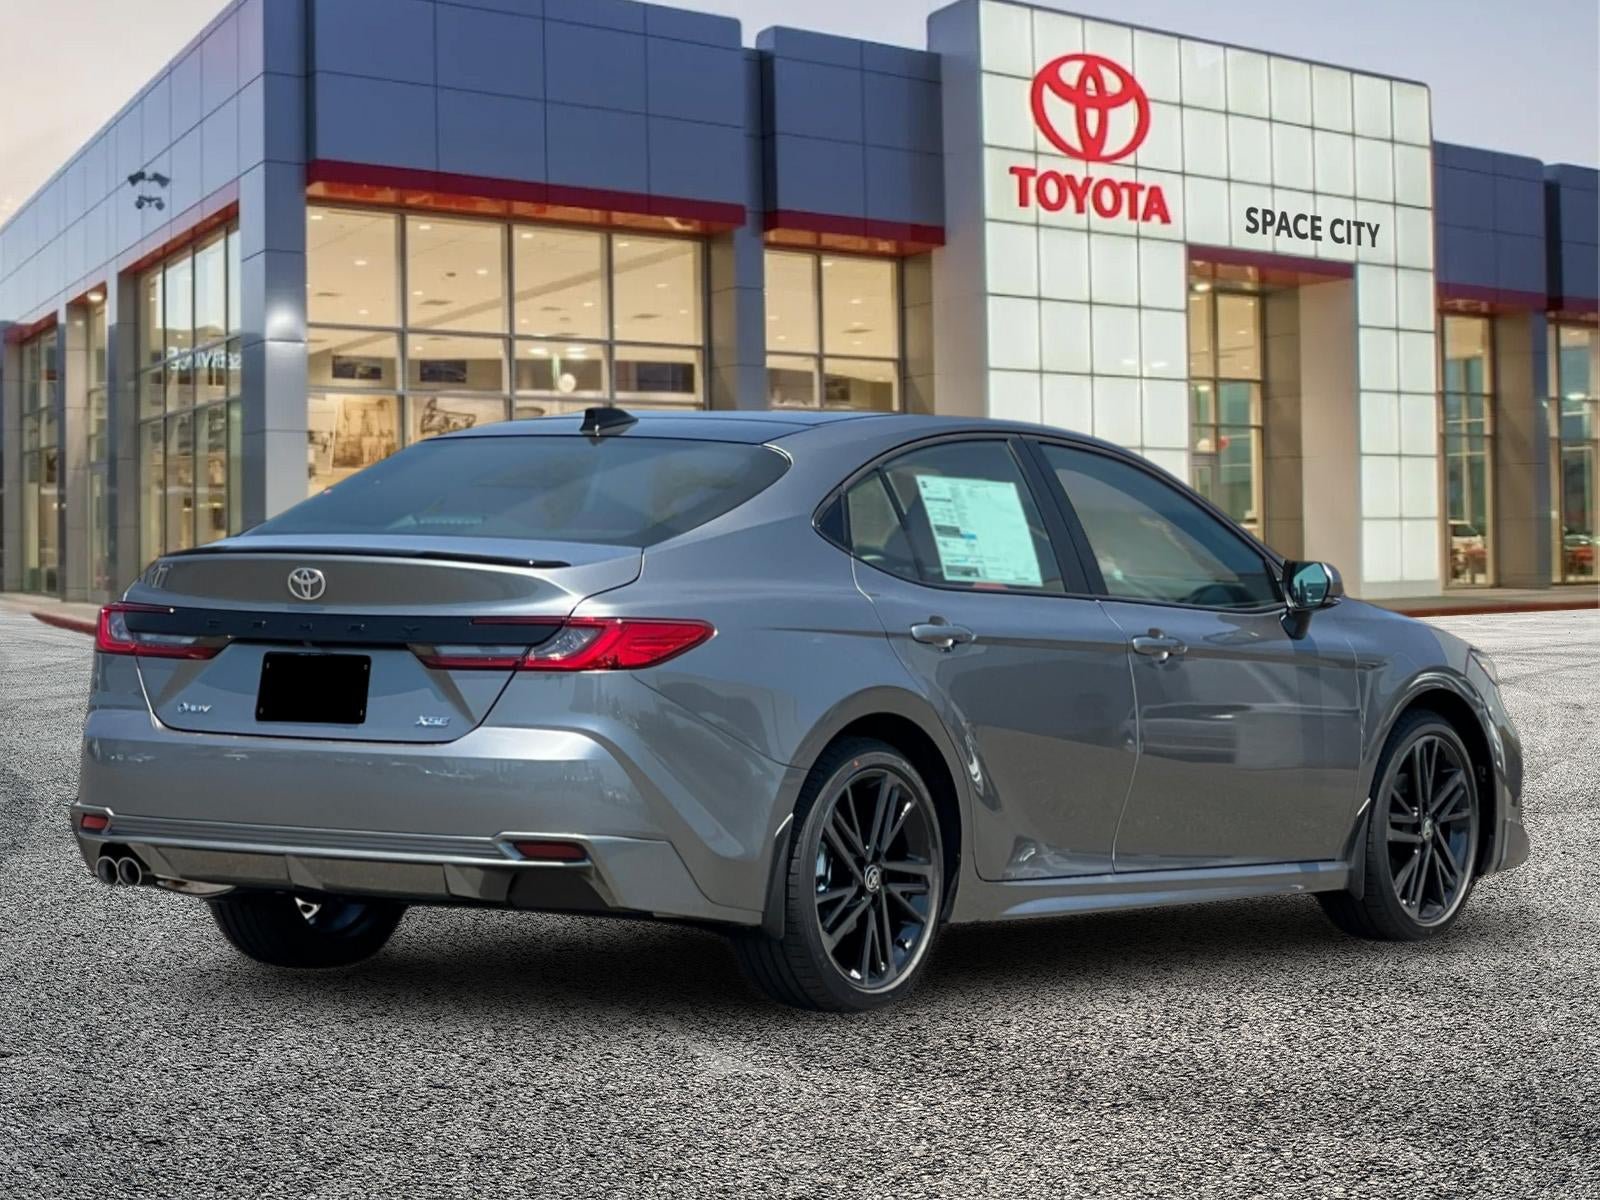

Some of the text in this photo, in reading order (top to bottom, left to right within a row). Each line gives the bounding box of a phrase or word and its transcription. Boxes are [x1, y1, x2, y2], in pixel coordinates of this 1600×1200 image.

[1009, 166, 1171, 225] TOYOTA
[1245, 206, 1380, 248] SPACE CITY
